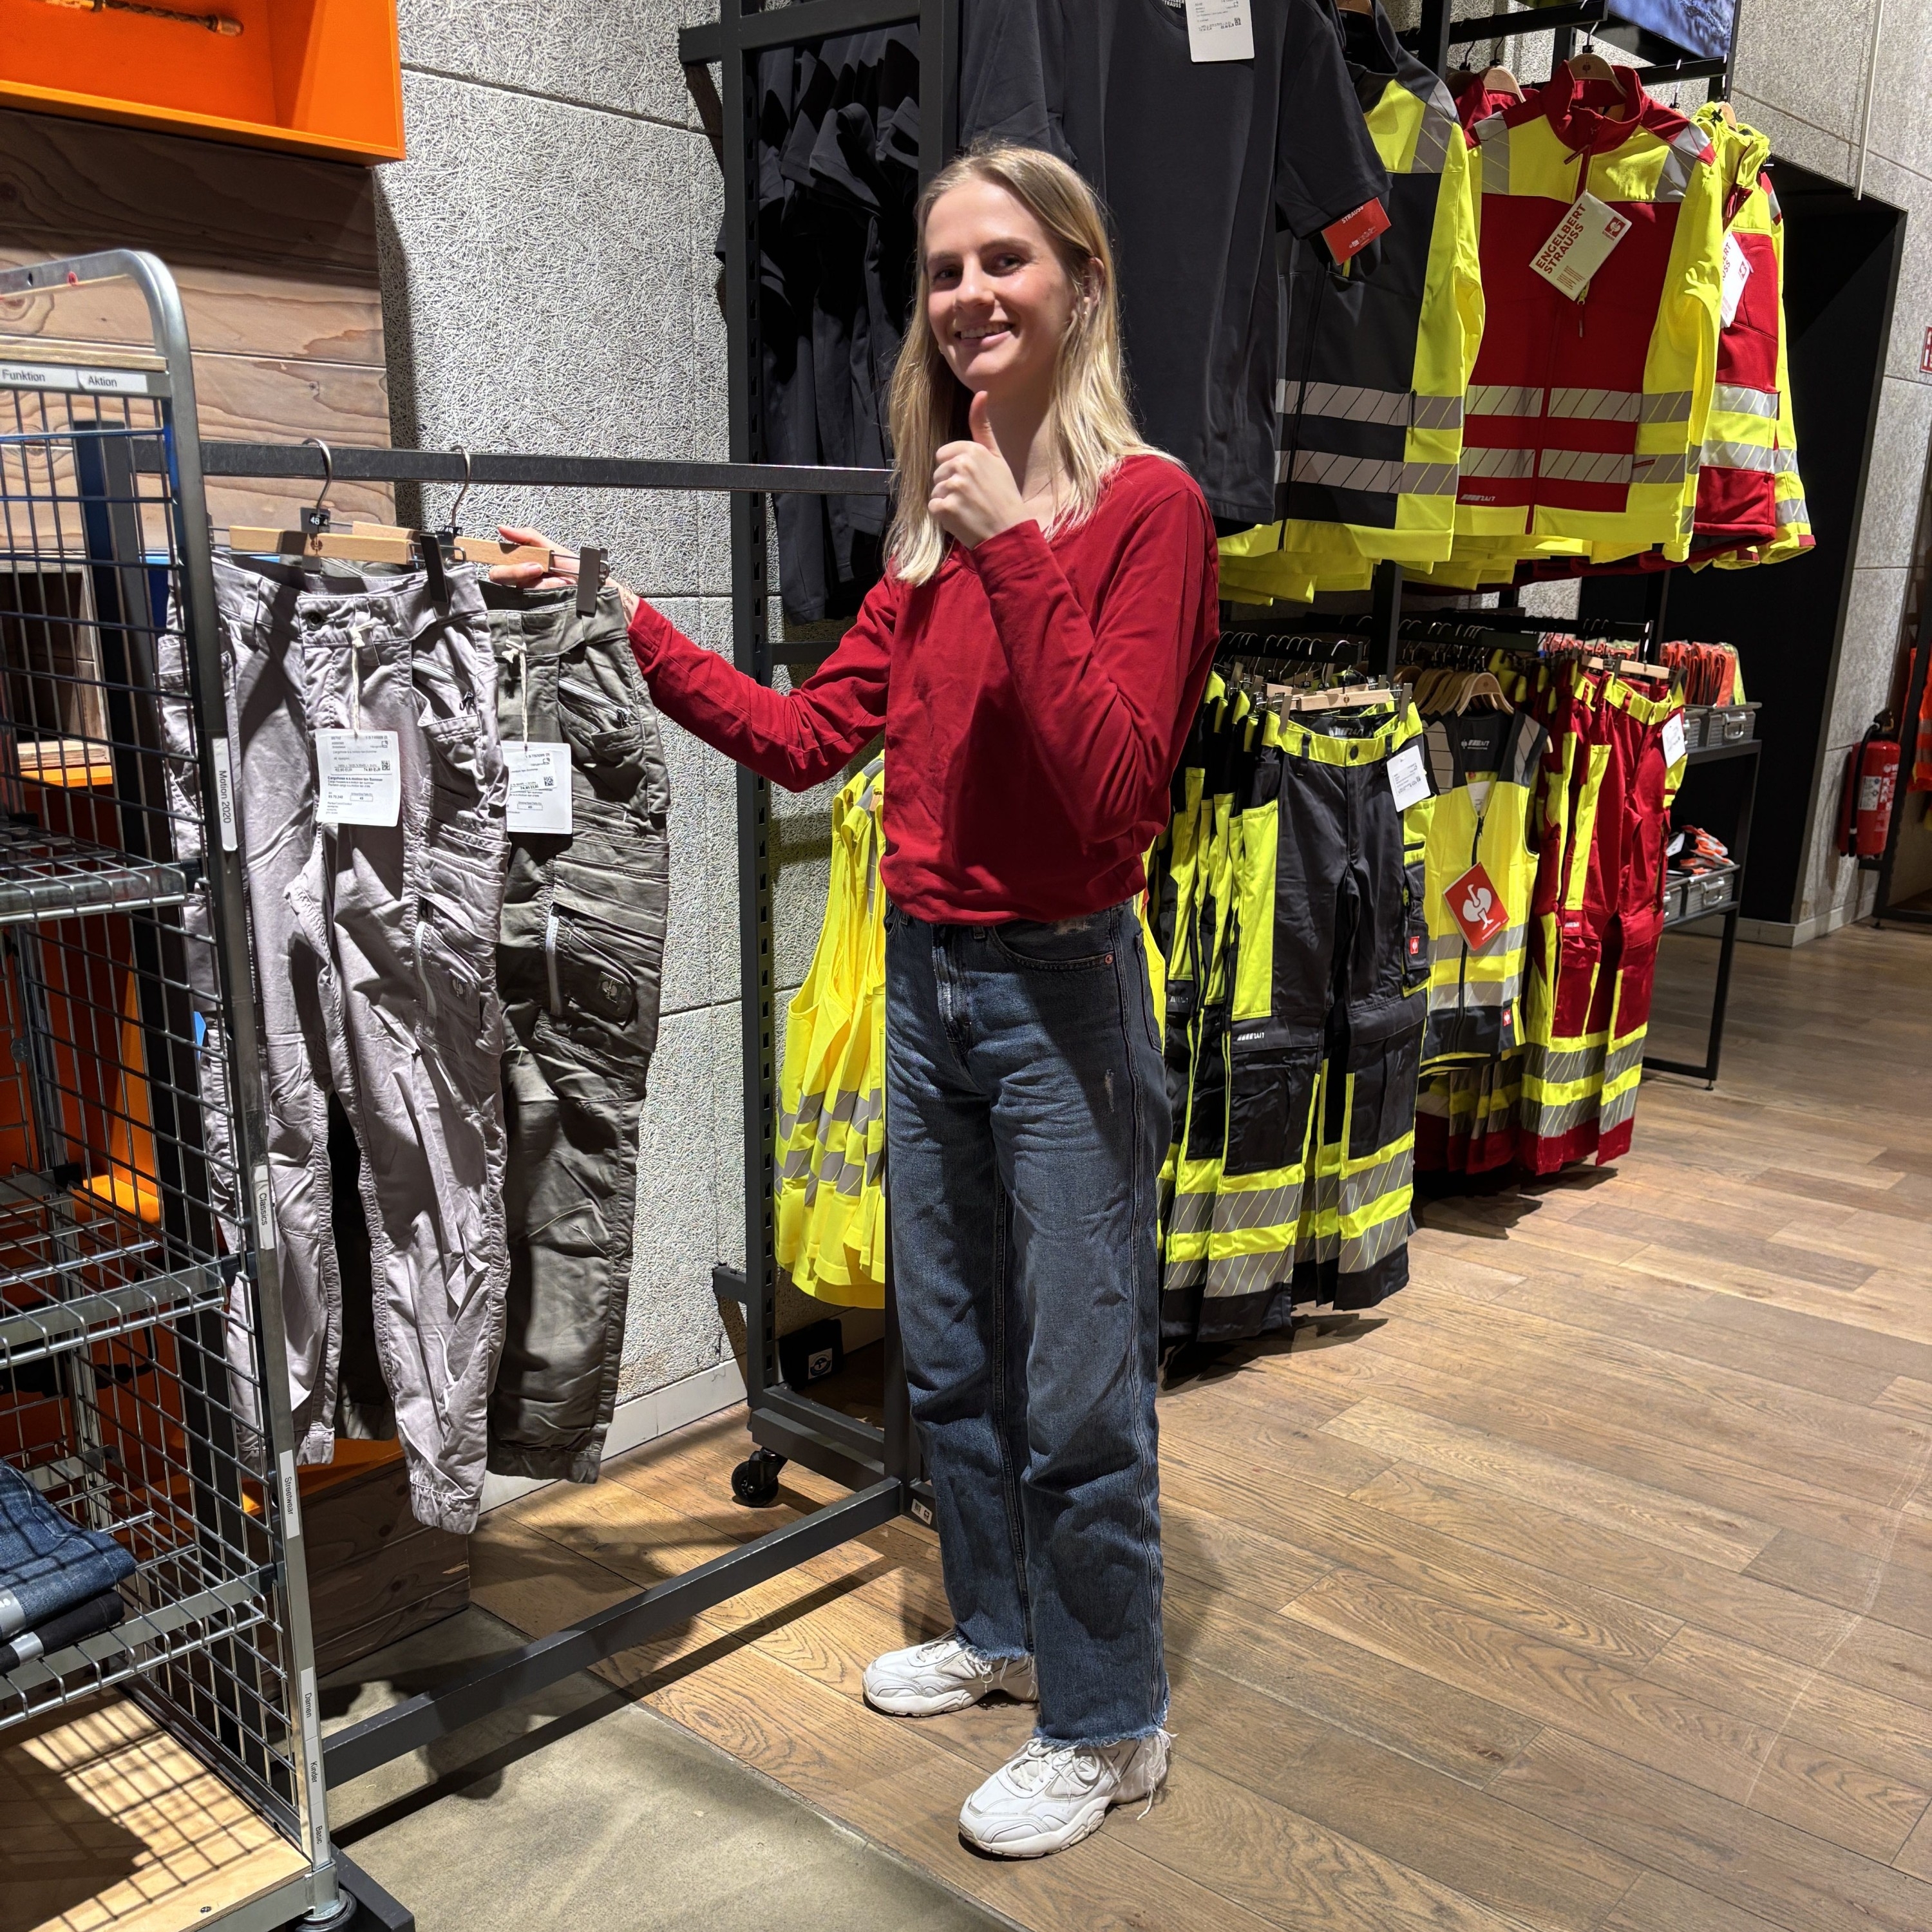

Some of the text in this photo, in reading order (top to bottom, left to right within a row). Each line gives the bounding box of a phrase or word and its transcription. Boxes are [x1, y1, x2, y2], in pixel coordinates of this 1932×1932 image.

[1535, 204, 1586, 269] ENGELBERT
[1544, 223, 1584, 274] STRAUSS
[2, 369, 46, 382] Funktion
[88, 375, 117, 387] Aktion
[310, 516, 320, 526] 48
[219, 771, 232, 823] Motion 2020
[259, 1193, 267, 1226] Classics
[285, 1476, 293, 1515] Streetwear
